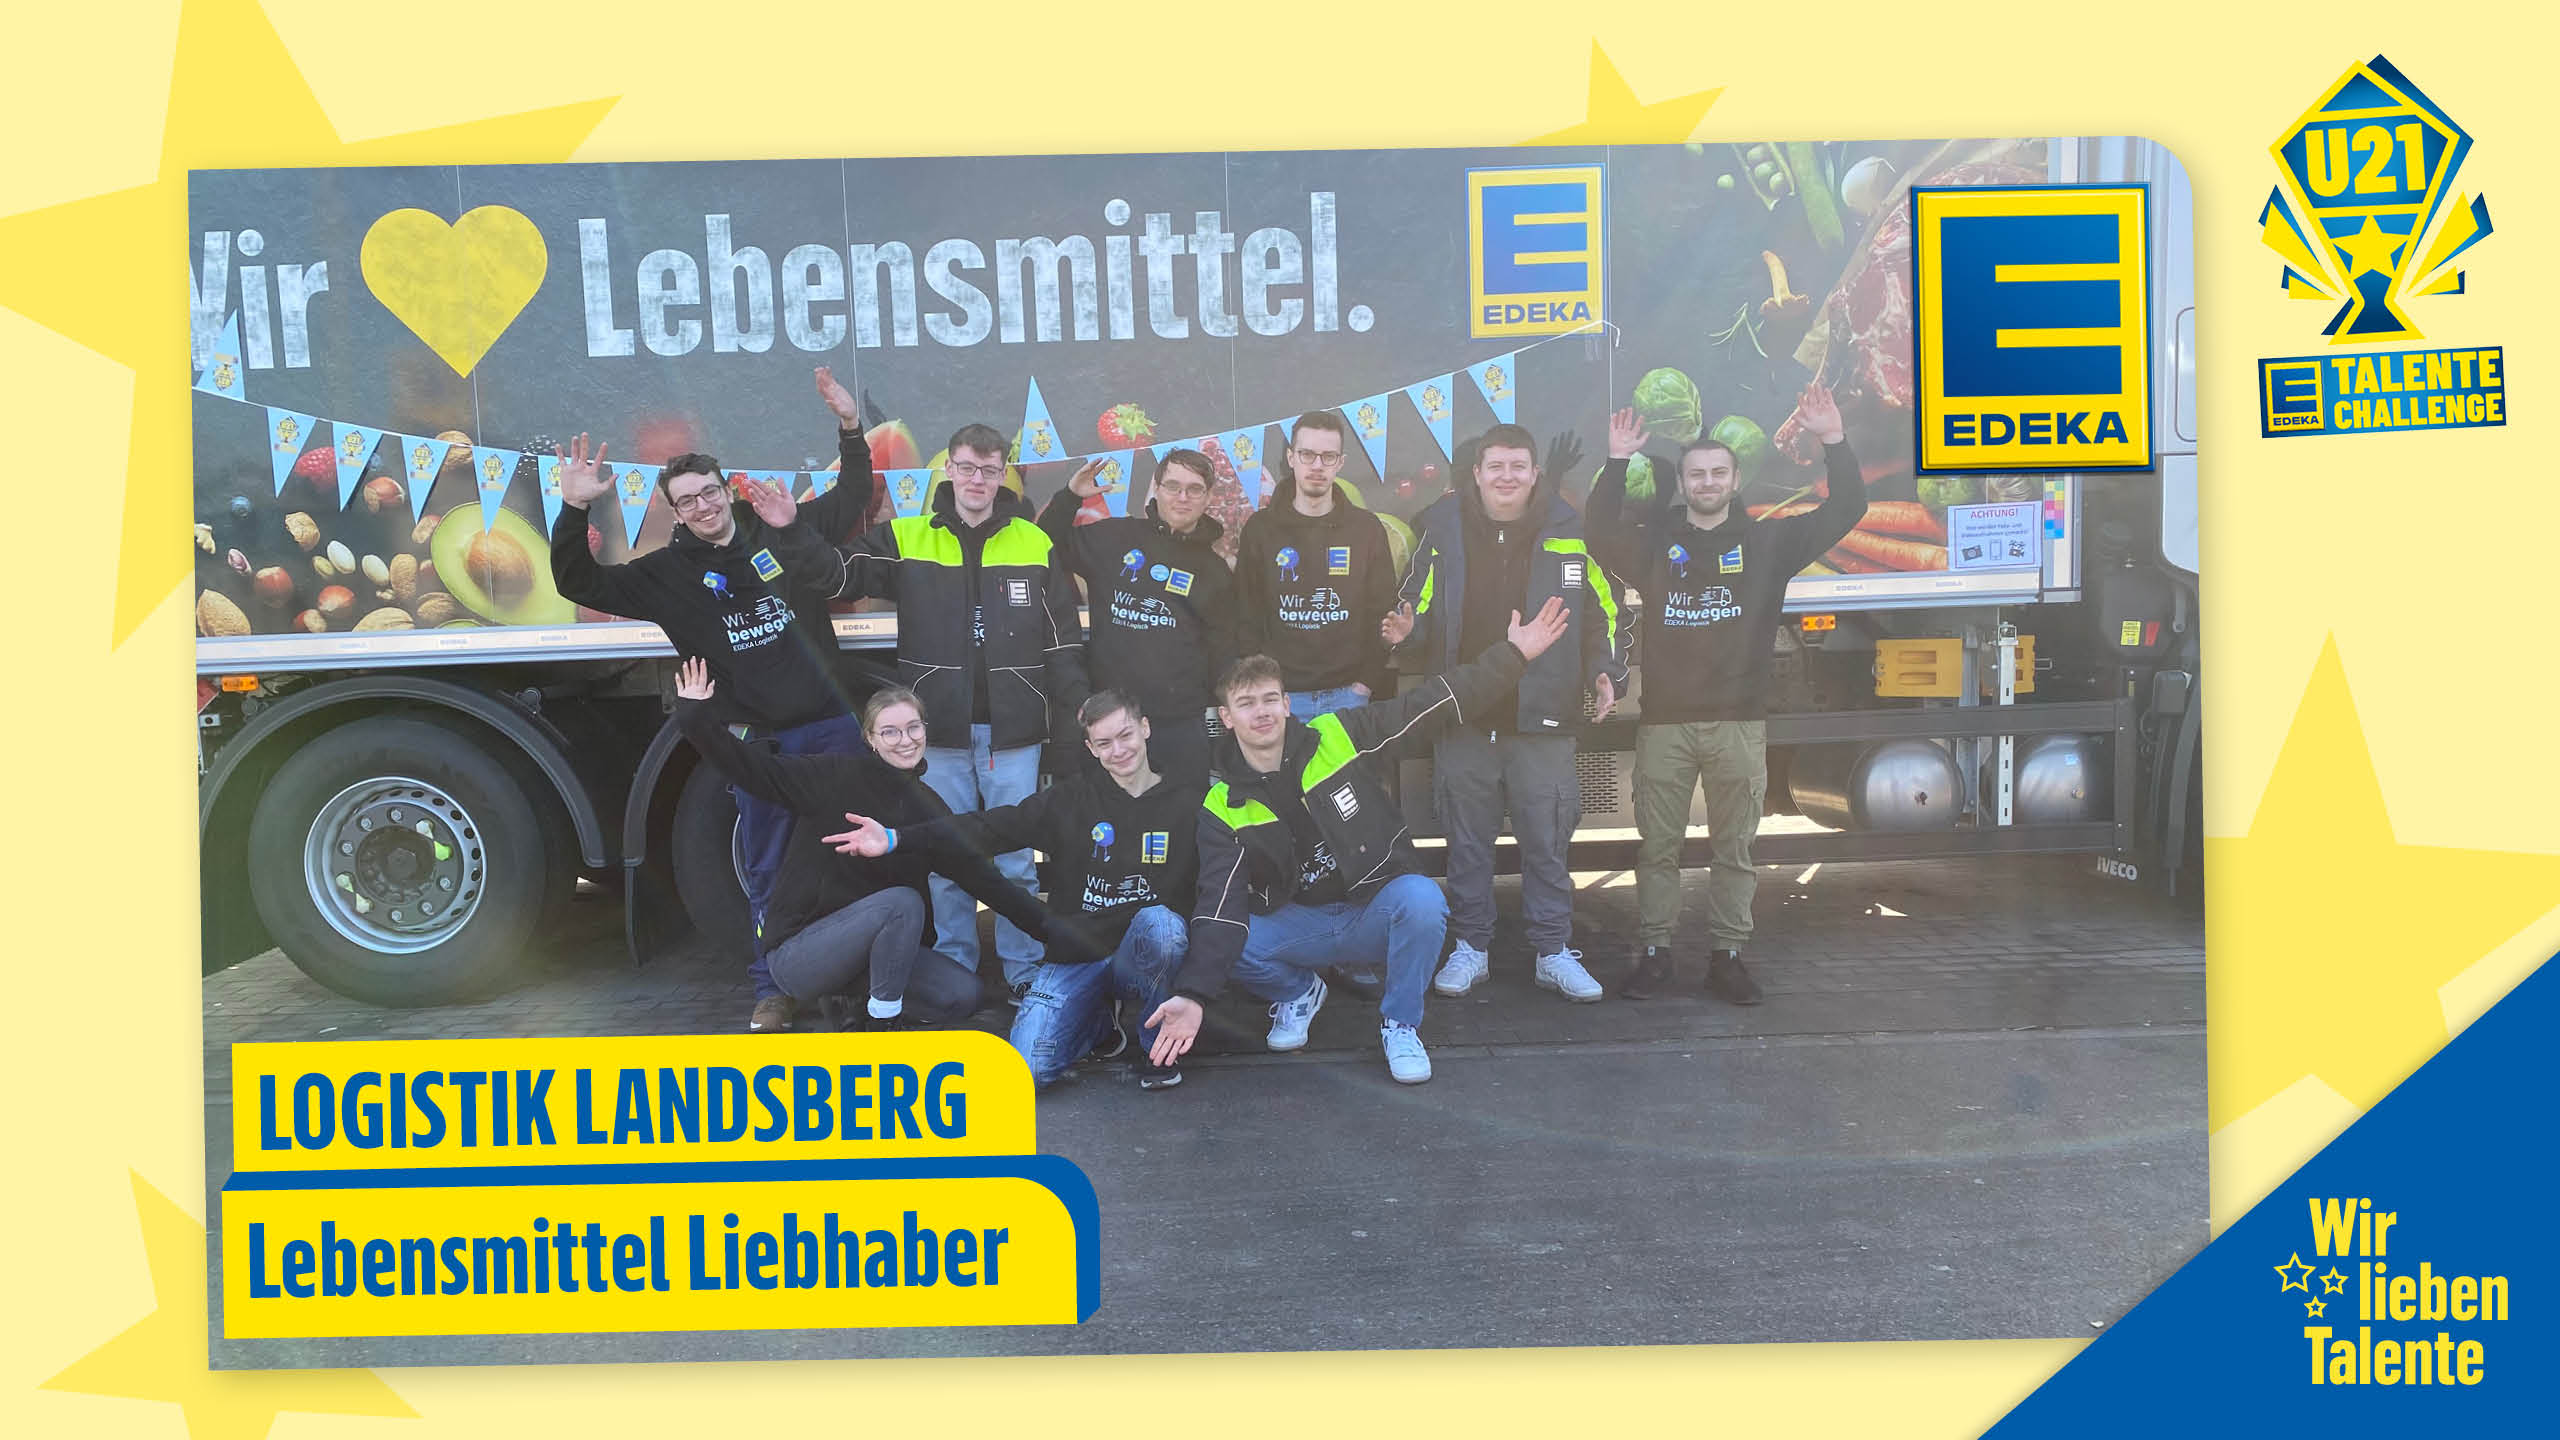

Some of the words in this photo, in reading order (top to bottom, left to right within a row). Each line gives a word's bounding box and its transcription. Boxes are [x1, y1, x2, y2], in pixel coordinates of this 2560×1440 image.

[1482, 182, 1588, 295] E
[578, 192, 1375, 357] Lebensmittel.
[1483, 301, 1592, 324] EDEKA
[1971, 508, 2018, 518] ACHTUNG!
[1114, 589, 1136, 605] Wir
[1280, 594, 1304, 607] Wir
[1668, 591, 1694, 606] Wir
[1665, 604, 1741, 621] bewegen
[2097, 856, 2137, 880] IVECO
[1087, 874, 1112, 893] Wir
